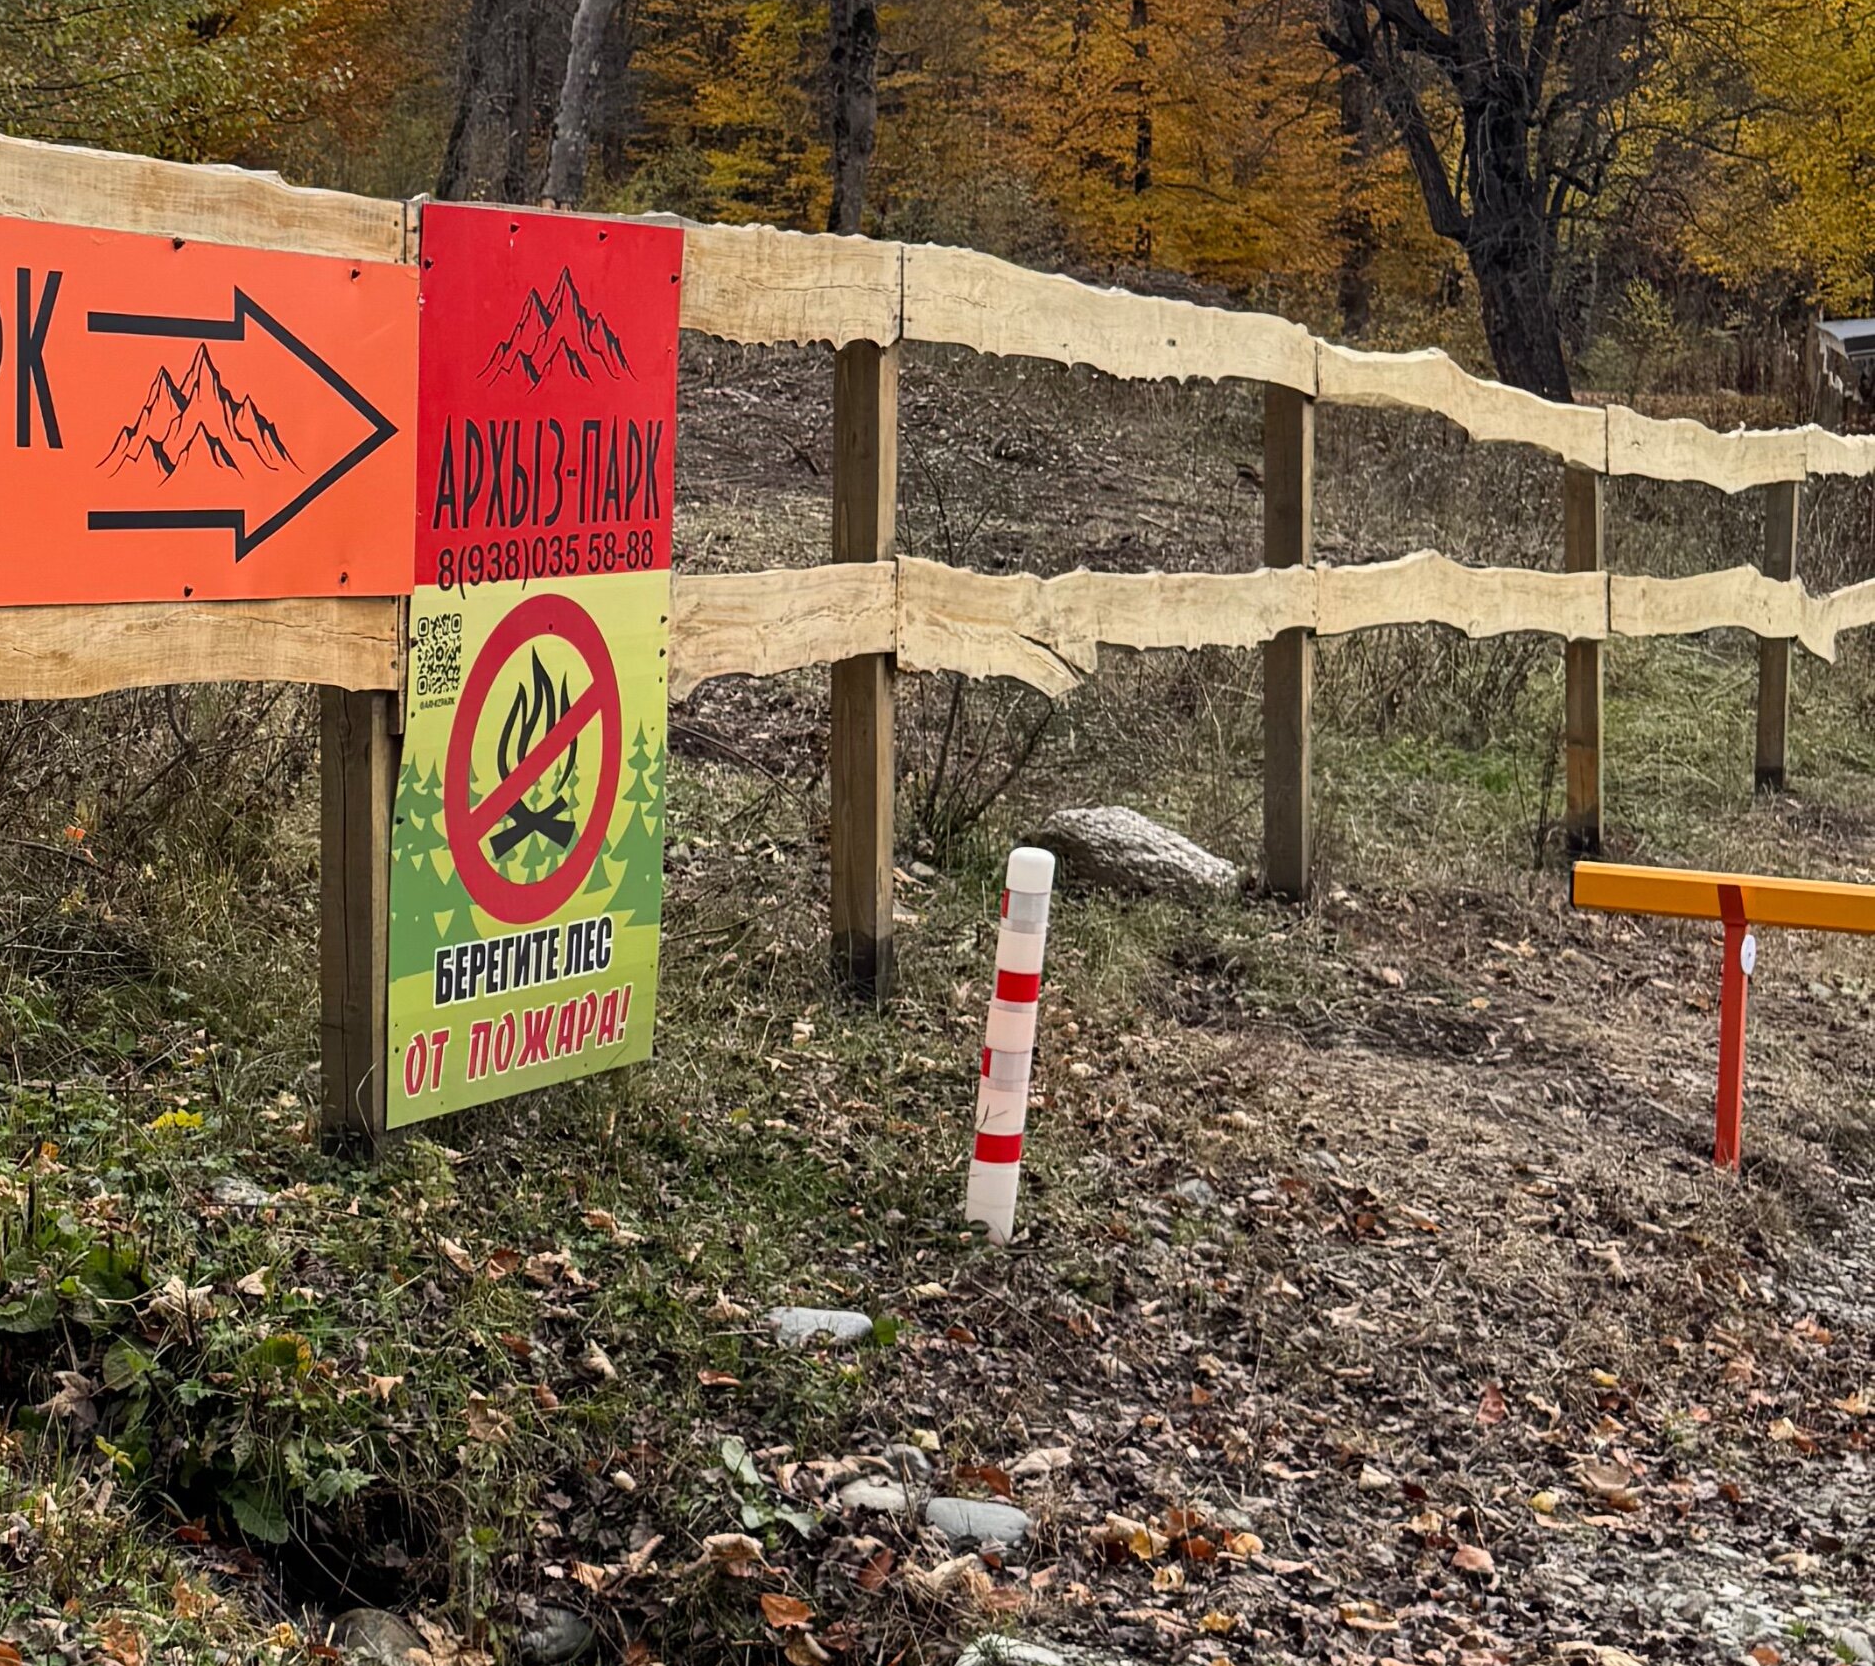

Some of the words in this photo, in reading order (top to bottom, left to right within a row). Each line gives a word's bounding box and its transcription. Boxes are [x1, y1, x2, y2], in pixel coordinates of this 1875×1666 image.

[432, 414, 664, 530] АРХЫЗ-ПАРК
[434, 927, 561, 1006] БЕРЕГИТЕ
[563, 916, 613, 978] ЛЕС
[404, 1030, 450, 1097] ОТ
[467, 983, 633, 1081] ПОЖАРА!
